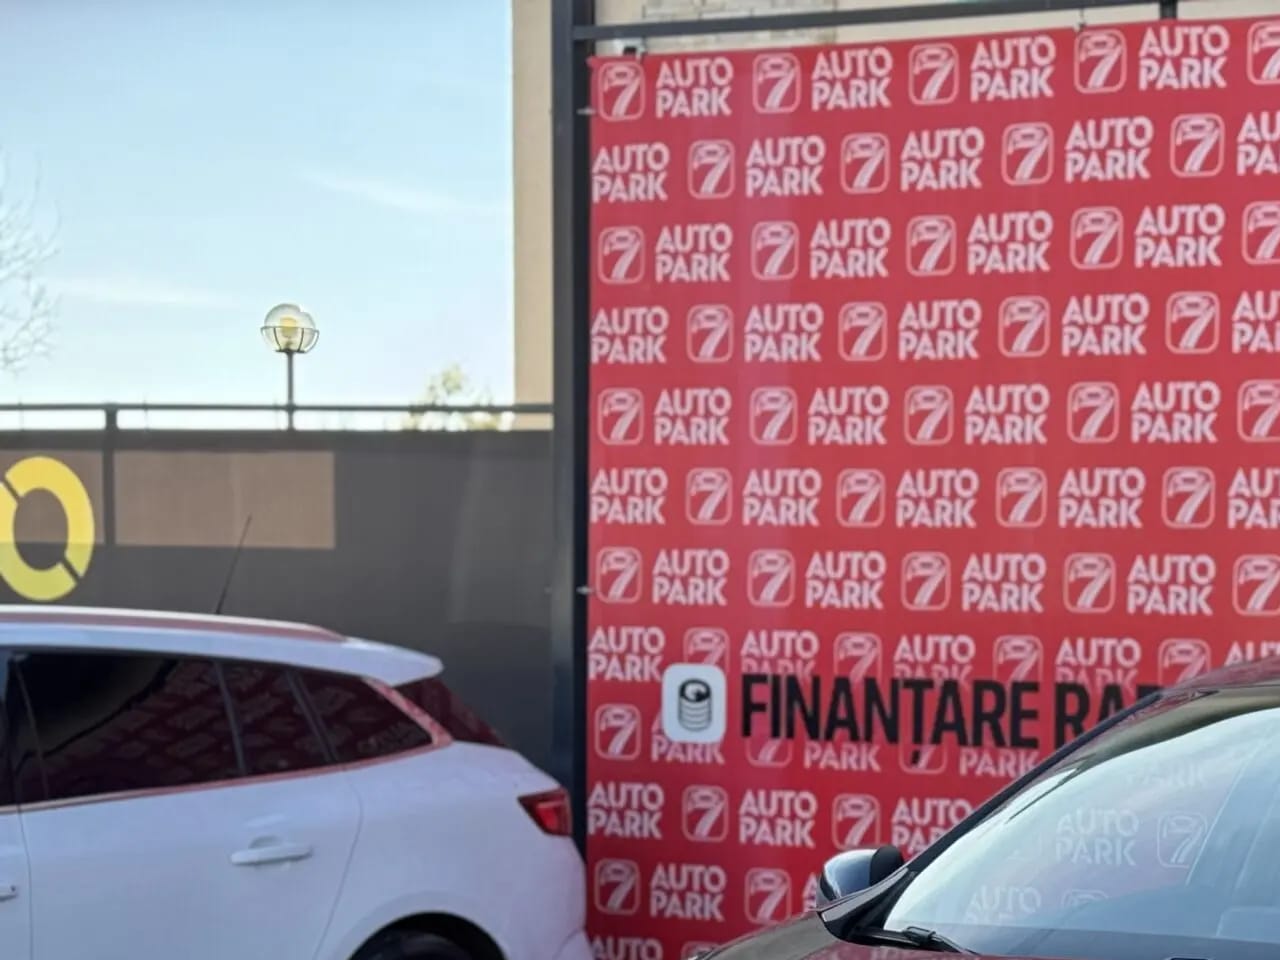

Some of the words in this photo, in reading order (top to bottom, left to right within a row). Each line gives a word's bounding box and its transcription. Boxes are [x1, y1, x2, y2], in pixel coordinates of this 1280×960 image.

[971, 35, 1056, 68] AUTO
[1139, 25, 1229, 57] AUTO
[656, 57, 734, 88] AUTO
[811, 47, 893, 80] AUTO
[1139, 56, 1227, 90] PARK
[811, 78, 892, 111] PARK
[971, 66, 1054, 102] PARK
[656, 86, 732, 118] PARK
[901, 127, 984, 160] AUTO
[1065, 116, 1153, 150] AUTO
[592, 142, 669, 174] AUTO
[746, 136, 825, 168] AUTO
[1065, 147, 1150, 182] PARK
[592, 171, 667, 204] PARK
[746, 165, 822, 197] PARK
[901, 156, 982, 191] PARK
[810, 217, 891, 249] AUTO
[968, 210, 1053, 244] AUTO
[1135, 204, 1225, 237] AUTO
[656, 223, 733, 254] AUTO
[1135, 234, 1221, 267] PARK
[656, 251, 730, 282] PARK
[810, 247, 888, 279] PARK
[968, 241, 1050, 274] PARK
[590, 306, 669, 336] AUTO
[745, 303, 824, 332] AUTO
[899, 299, 981, 331] AUTO
[1062, 293, 1149, 324] AUTO
[591, 334, 666, 365] PARK
[744, 332, 821, 362] PARK
[899, 328, 978, 360] PARK
[1062, 324, 1146, 356] PARK
[654, 387, 731, 417] AUTO
[808, 386, 889, 415] AUTO
[965, 384, 1050, 415] AUTO
[1131, 381, 1220, 412] AUTO
[655, 415, 728, 445] PARK
[808, 415, 886, 445] PARK
[965, 413, 1047, 444] PARK
[1131, 410, 1217, 443] PARK
[590, 468, 668, 496] AUTO
[743, 468, 822, 497] AUTO
[896, 468, 979, 498] AUTO
[1059, 467, 1145, 498] AUTO
[590, 494, 665, 524] PARK
[743, 495, 819, 526] PARK
[896, 496, 976, 528] PARK
[1059, 496, 1142, 528] PARK
[653, 549, 729, 577] AUTO
[806, 551, 886, 580] AUTO
[962, 553, 1046, 583] AUTO
[1128, 555, 1216, 585] AUTO
[653, 575, 726, 605] PARK
[806, 578, 883, 609] PARK
[962, 581, 1043, 613] PARK
[1128, 583, 1212, 616] PARK
[588, 627, 664, 655] AUTO
[741, 631, 818, 659] AUTO
[894, 636, 975, 663] AUTO
[1056, 638, 1141, 668] AUTO
[588, 652, 663, 681] PARK
[652, 735, 724, 764] PARK
[803, 740, 881, 772] PARK
[587, 782, 664, 811] AUTO
[739, 790, 817, 819] AUTO
[892, 798, 971, 826] AUTO
[587, 807, 662, 839] PARK
[739, 815, 814, 848] PARK
[650, 864, 726, 893] AUTO
[650, 888, 723, 921] PARK
